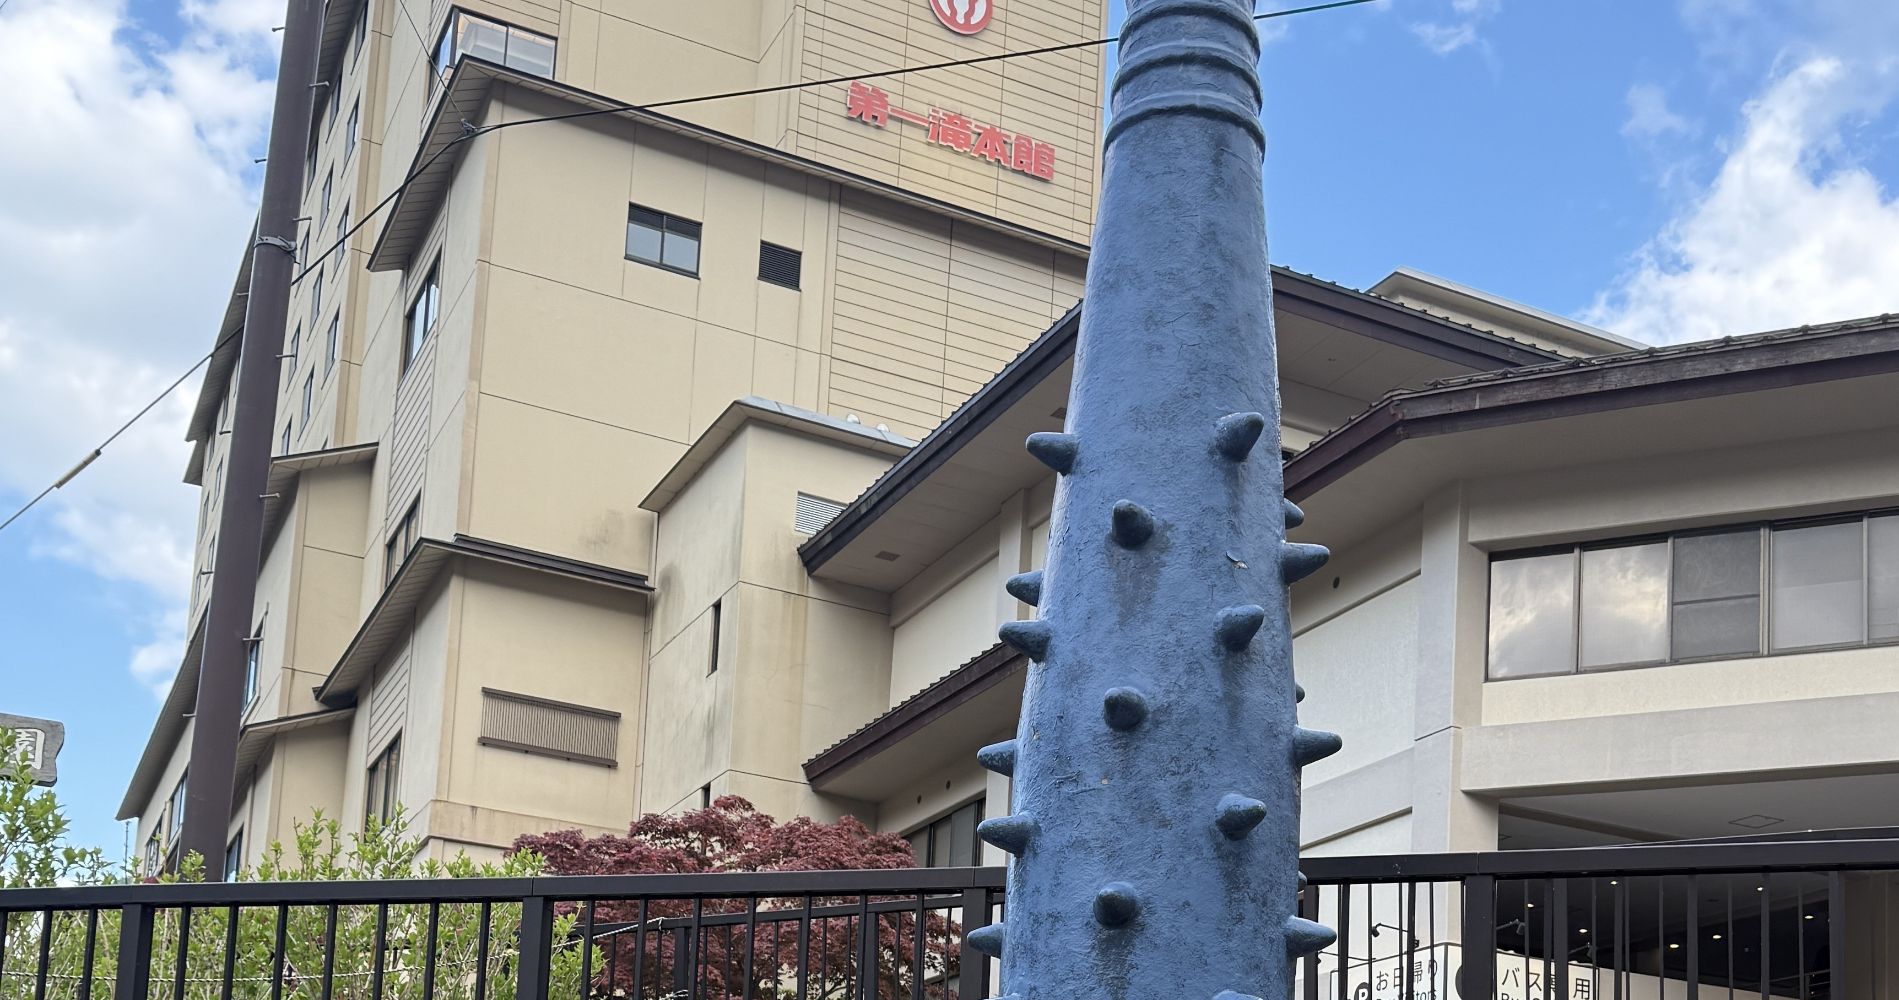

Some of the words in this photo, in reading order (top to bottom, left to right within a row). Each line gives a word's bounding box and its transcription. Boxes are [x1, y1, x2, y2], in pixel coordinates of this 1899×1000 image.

[847, 80, 1055, 181] 第一滝本館
[1501, 967, 1591, 1000] バス用
